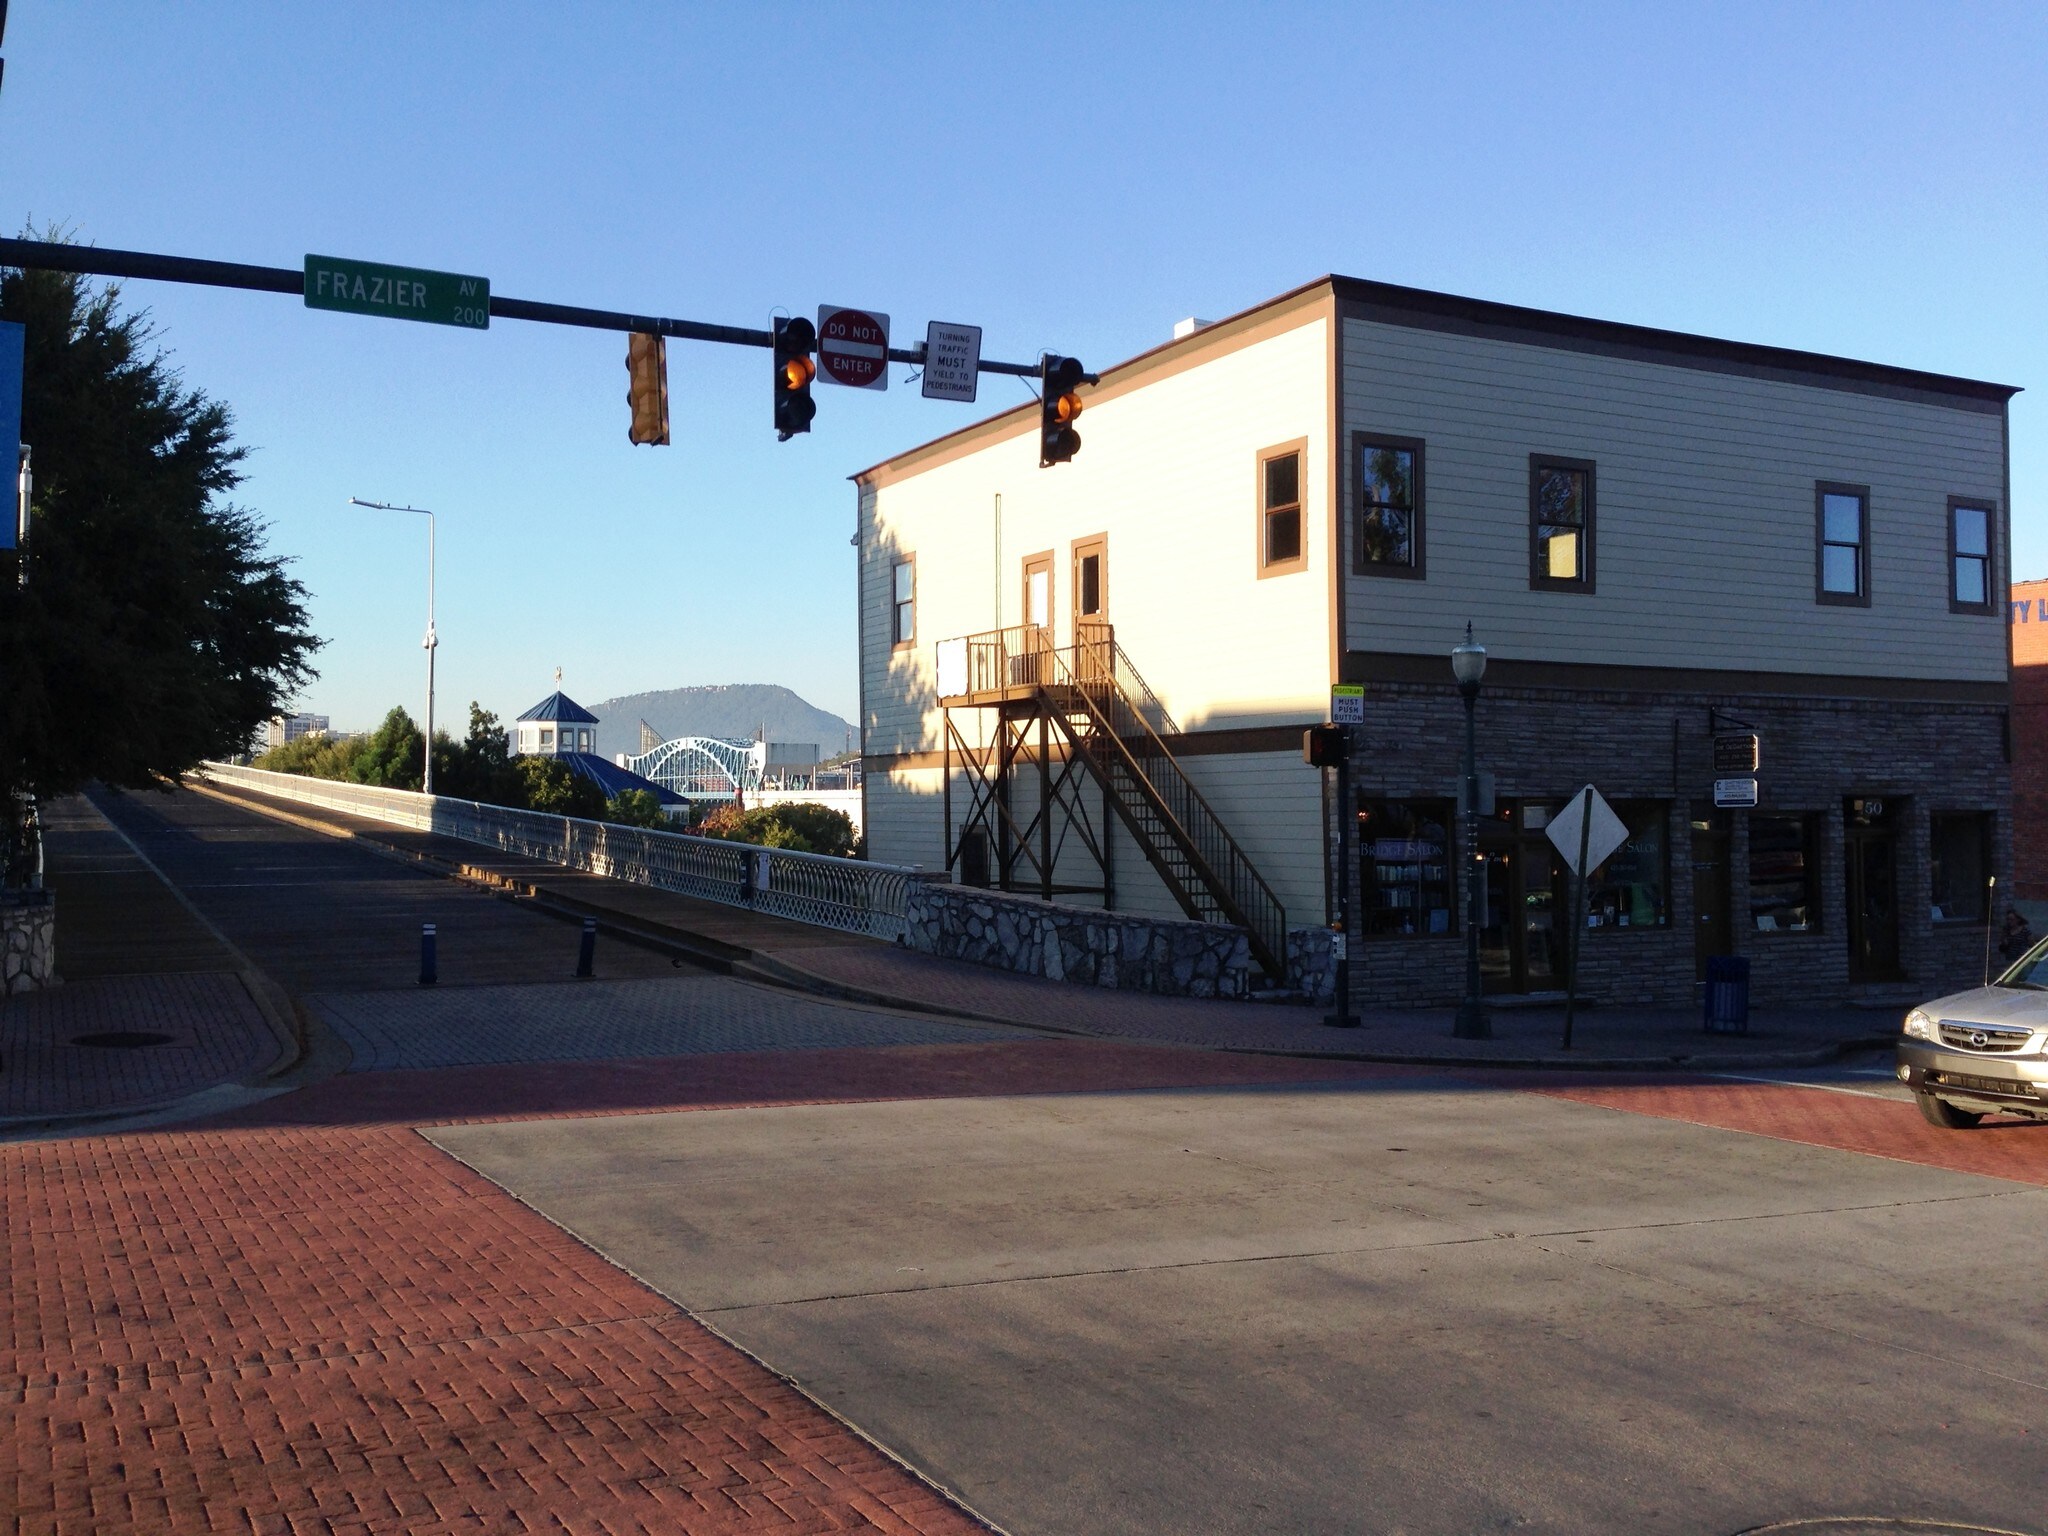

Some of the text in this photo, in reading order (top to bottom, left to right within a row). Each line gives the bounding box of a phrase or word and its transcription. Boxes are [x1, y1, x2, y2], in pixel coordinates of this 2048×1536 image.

[316, 270, 427, 308] FRAZIER
[459, 279, 478, 297] AV
[453, 306, 485, 325] 200
[829, 322, 878, 341] DO NOT
[938, 332, 970, 344] TURNING
[938, 344, 968, 355] TRAFFIC
[834, 357, 872, 374] ENTER
[937, 357, 966, 369] MUST
[932, 369, 969, 381] YIELD TO
[926, 380, 973, 393] PEDESTRIANS
[1338, 698, 1358, 706] MUST
[1338, 706, 1359, 714] PUSH
[1864, 801, 1883, 815] 50
[1360, 841, 1444, 857] BRIDGE SALON
[1626, 840, 1659, 854] SALON
